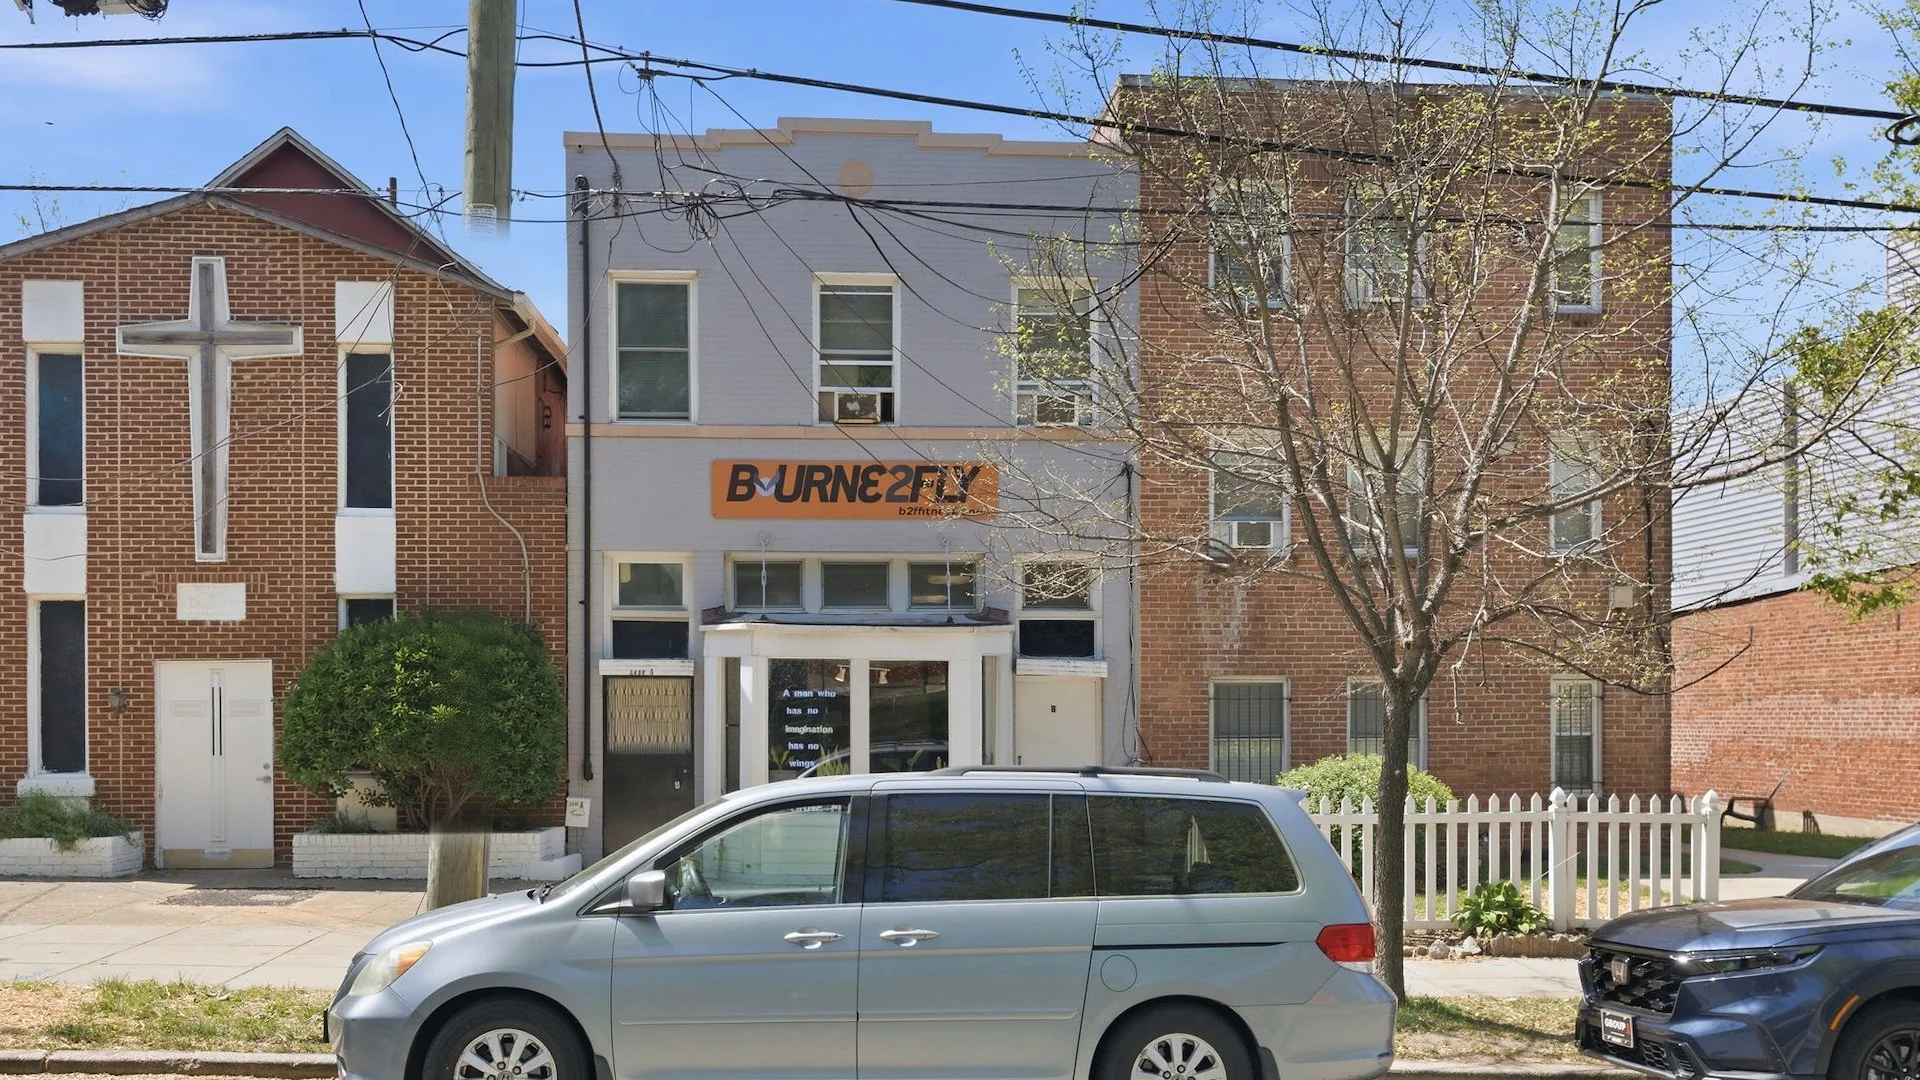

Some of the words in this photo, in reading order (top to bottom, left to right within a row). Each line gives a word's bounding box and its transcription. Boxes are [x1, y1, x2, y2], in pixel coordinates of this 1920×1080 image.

[783, 688, 791, 698] A
[794, 690, 814, 698] man
[817, 689, 837, 698] who
[786, 706, 802, 715] has
[807, 707, 819, 715] no
[788, 741, 804, 750] has
[789, 759, 815, 769] wings
